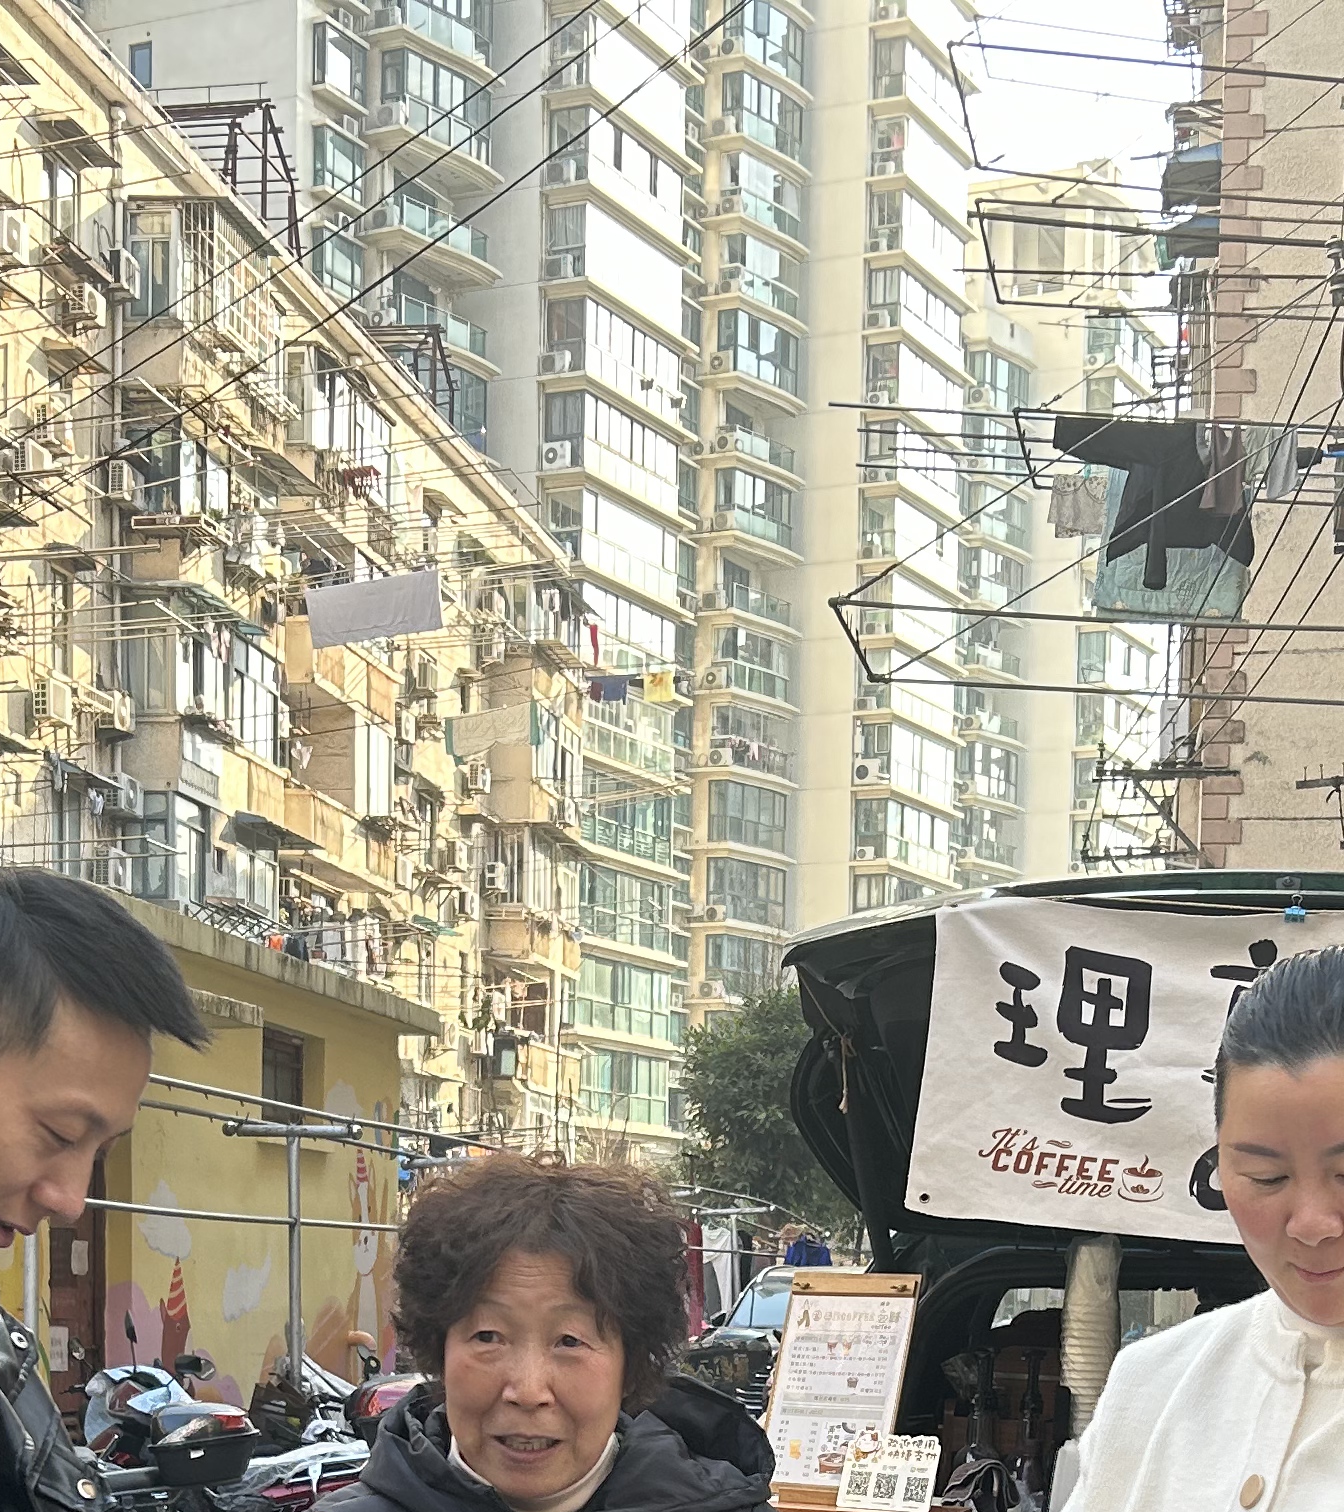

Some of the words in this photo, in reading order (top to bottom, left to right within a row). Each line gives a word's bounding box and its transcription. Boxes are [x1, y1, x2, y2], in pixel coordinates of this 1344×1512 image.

[978, 1127, 1039, 1158] It's
[991, 1148, 1119, 1183] COFFEE
[1057, 1175, 1113, 1198] time
